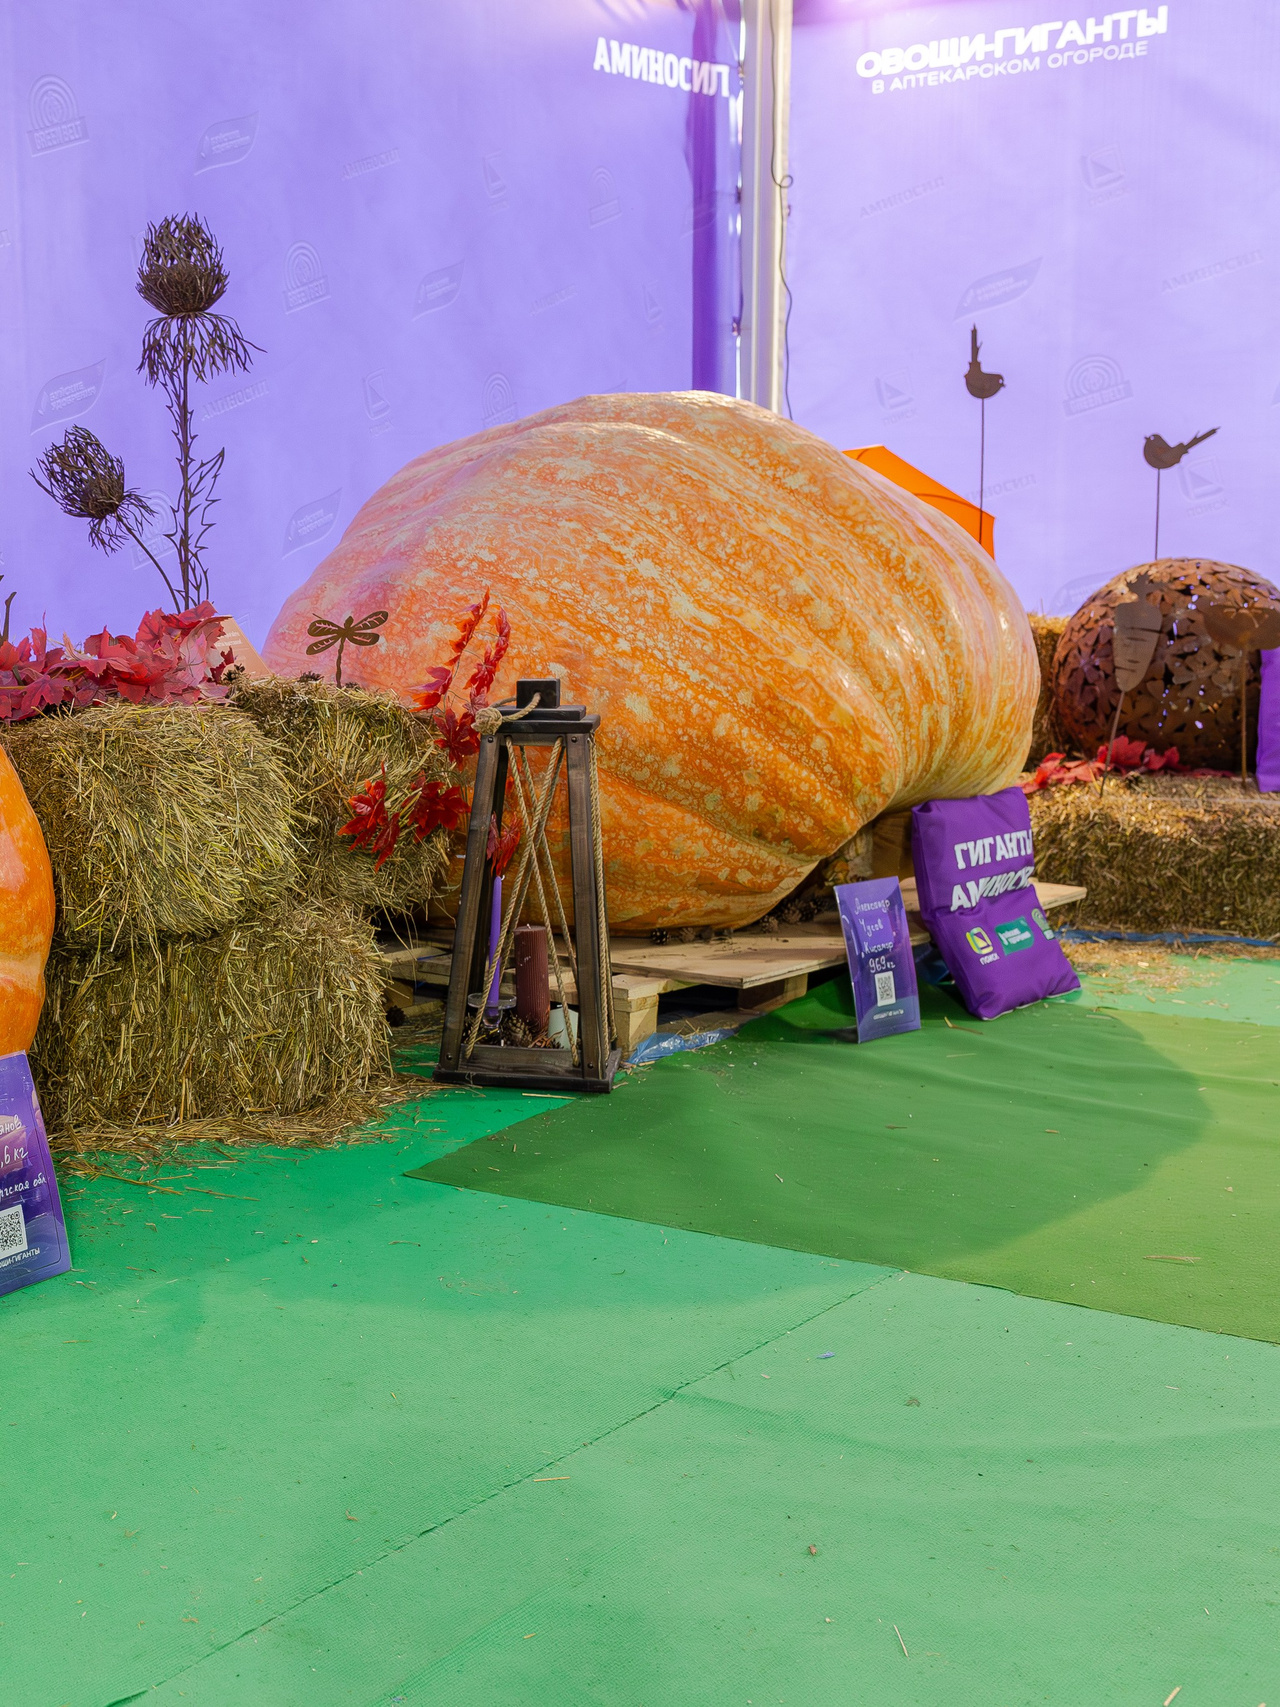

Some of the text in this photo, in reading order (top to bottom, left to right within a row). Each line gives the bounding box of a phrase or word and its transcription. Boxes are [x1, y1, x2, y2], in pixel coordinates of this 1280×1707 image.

[592, 36, 731, 99] АМИНОСИЛ
[855, 4, 1169, 79] ОВОЩИ-ГИГАНТЫ
[871, 39, 1149, 95] В АПТЕКАРСКОМ ОГОРОДЕ
[868, 955, 887, 974] 969
[13, 1147, 29, 1161] кг
